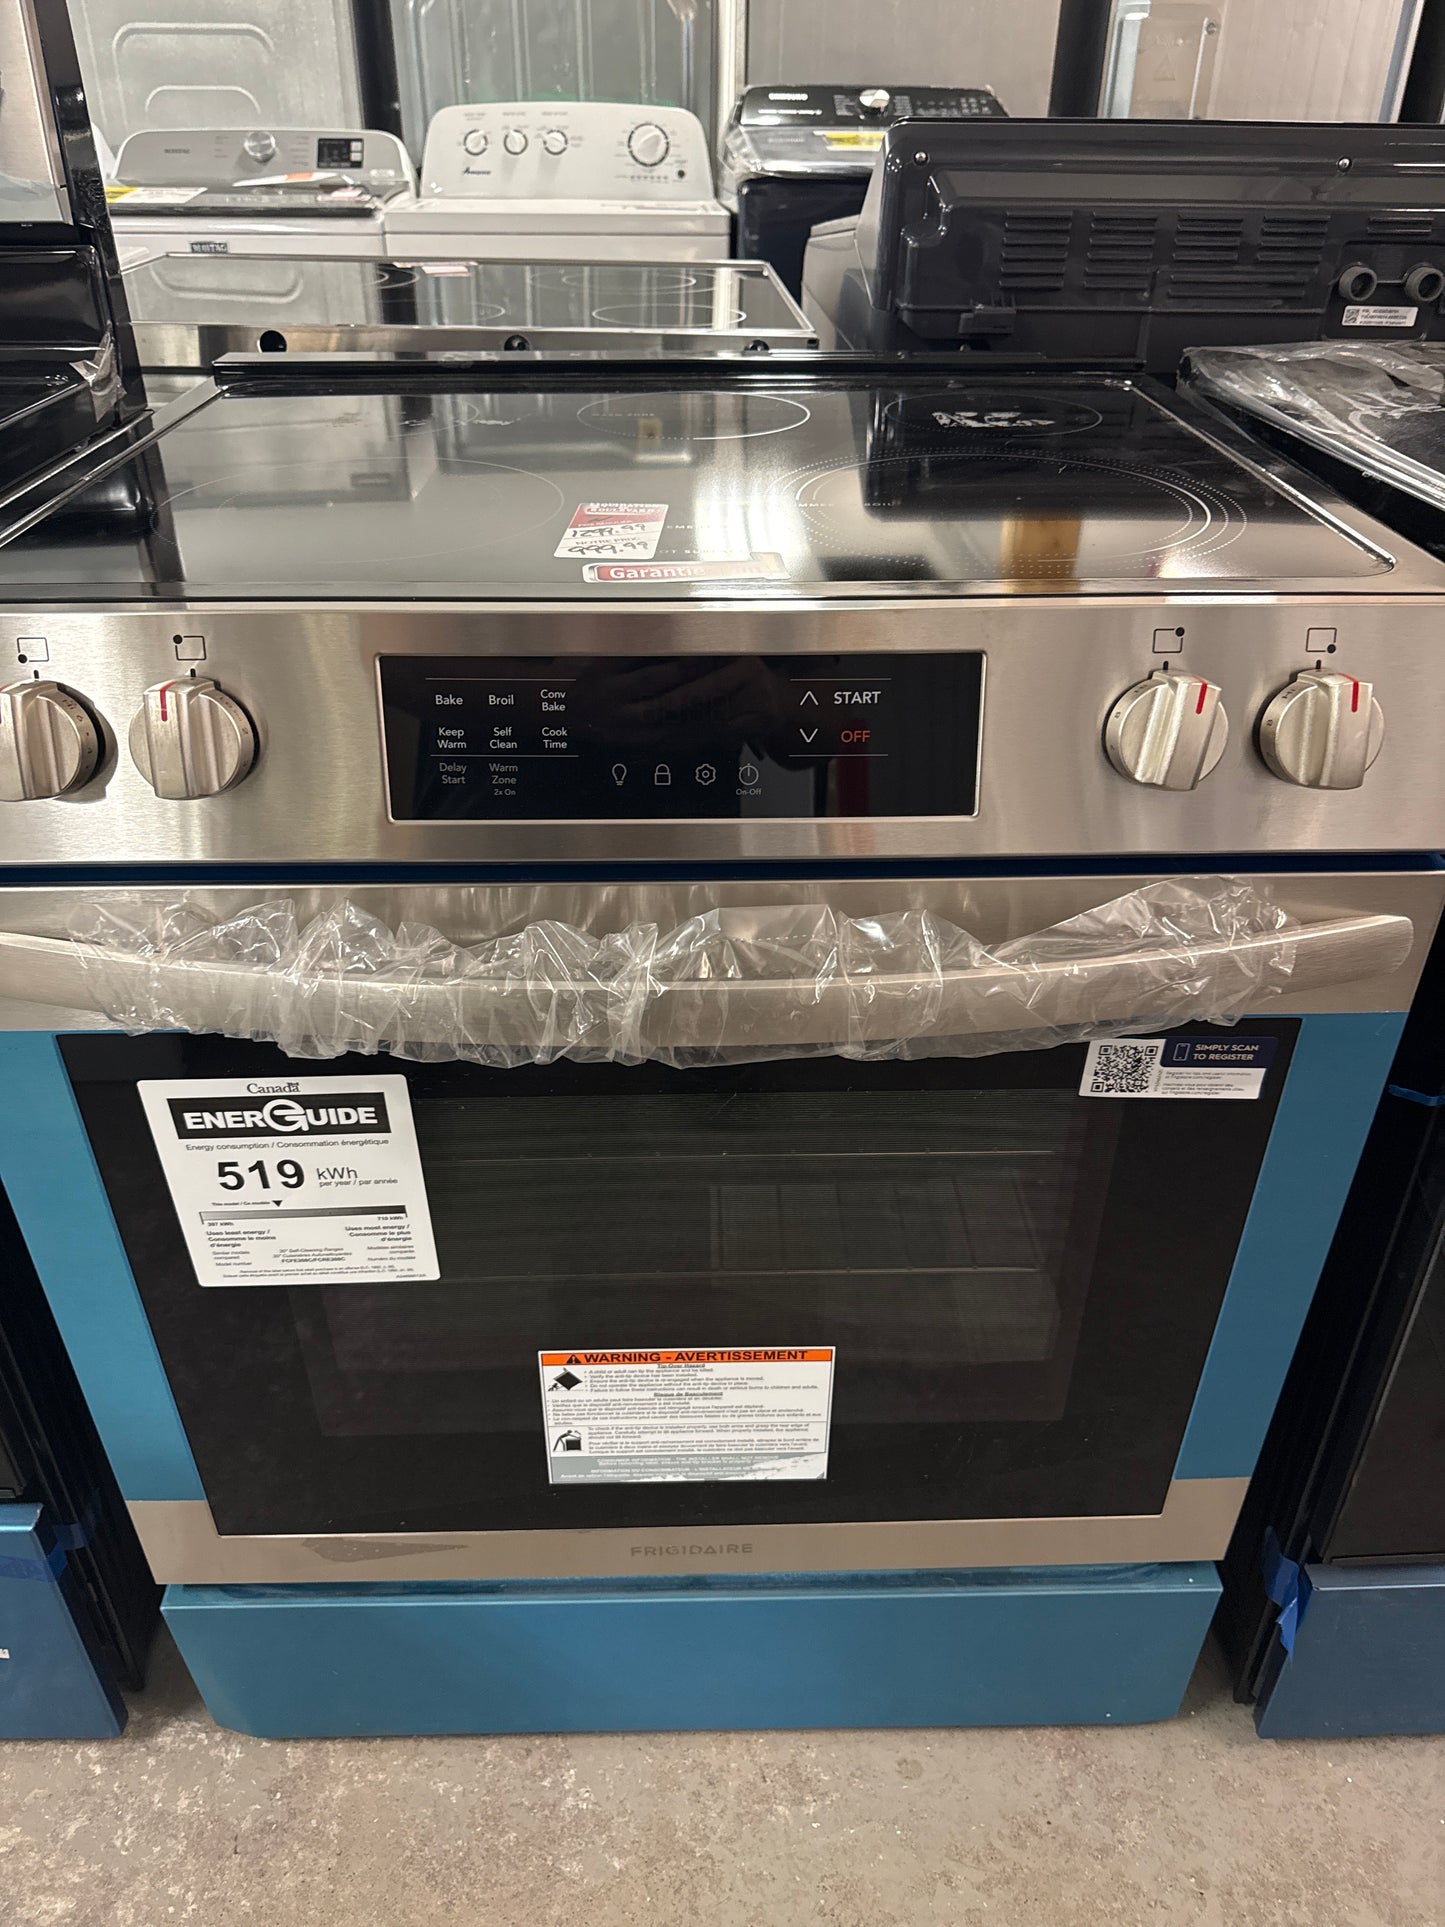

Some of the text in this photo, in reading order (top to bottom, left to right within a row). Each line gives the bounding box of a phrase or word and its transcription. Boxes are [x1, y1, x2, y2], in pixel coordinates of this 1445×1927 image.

[568, 541, 648, 555] 999.99
[609, 564, 706, 580] Garantie
[435, 695, 464, 706] Bake
[488, 694, 515, 706] Broil
[540, 690, 566, 700] Conv
[833, 691, 882, 705] START
[542, 702, 566, 712] Bake
[438, 727, 465, 739] Keep
[493, 726, 513, 737] Self
[542, 727, 568, 737] Cook
[840, 730, 871, 743] OFF
[437, 740, 467, 749] Warm
[489, 739, 518, 749] Clean
[543, 740, 568, 749] Time
[439, 763, 467, 774] Delay
[489, 763, 519, 772] Warm
[441, 775, 466, 785] Start
[492, 775, 517, 785] Zone
[504, 788, 516, 796] On
[736, 788, 762, 796] On-Off
[246, 1082, 300, 1095] Canada
[183, 1098, 379, 1132] ENERGUIDE
[185, 1143, 214, 1151] Energy
[216, 1142, 269, 1150] consumption
[341, 1139, 389, 1147] énergétique
[217, 1159, 305, 1190] 519
[316, 1167, 358, 1180] kWh
[584, 1353, 661, 1363] WARNING
[675, 1351, 808, 1362] AVERTISSEMENT
[630, 1544, 753, 1557] FRIGIDAIRE
